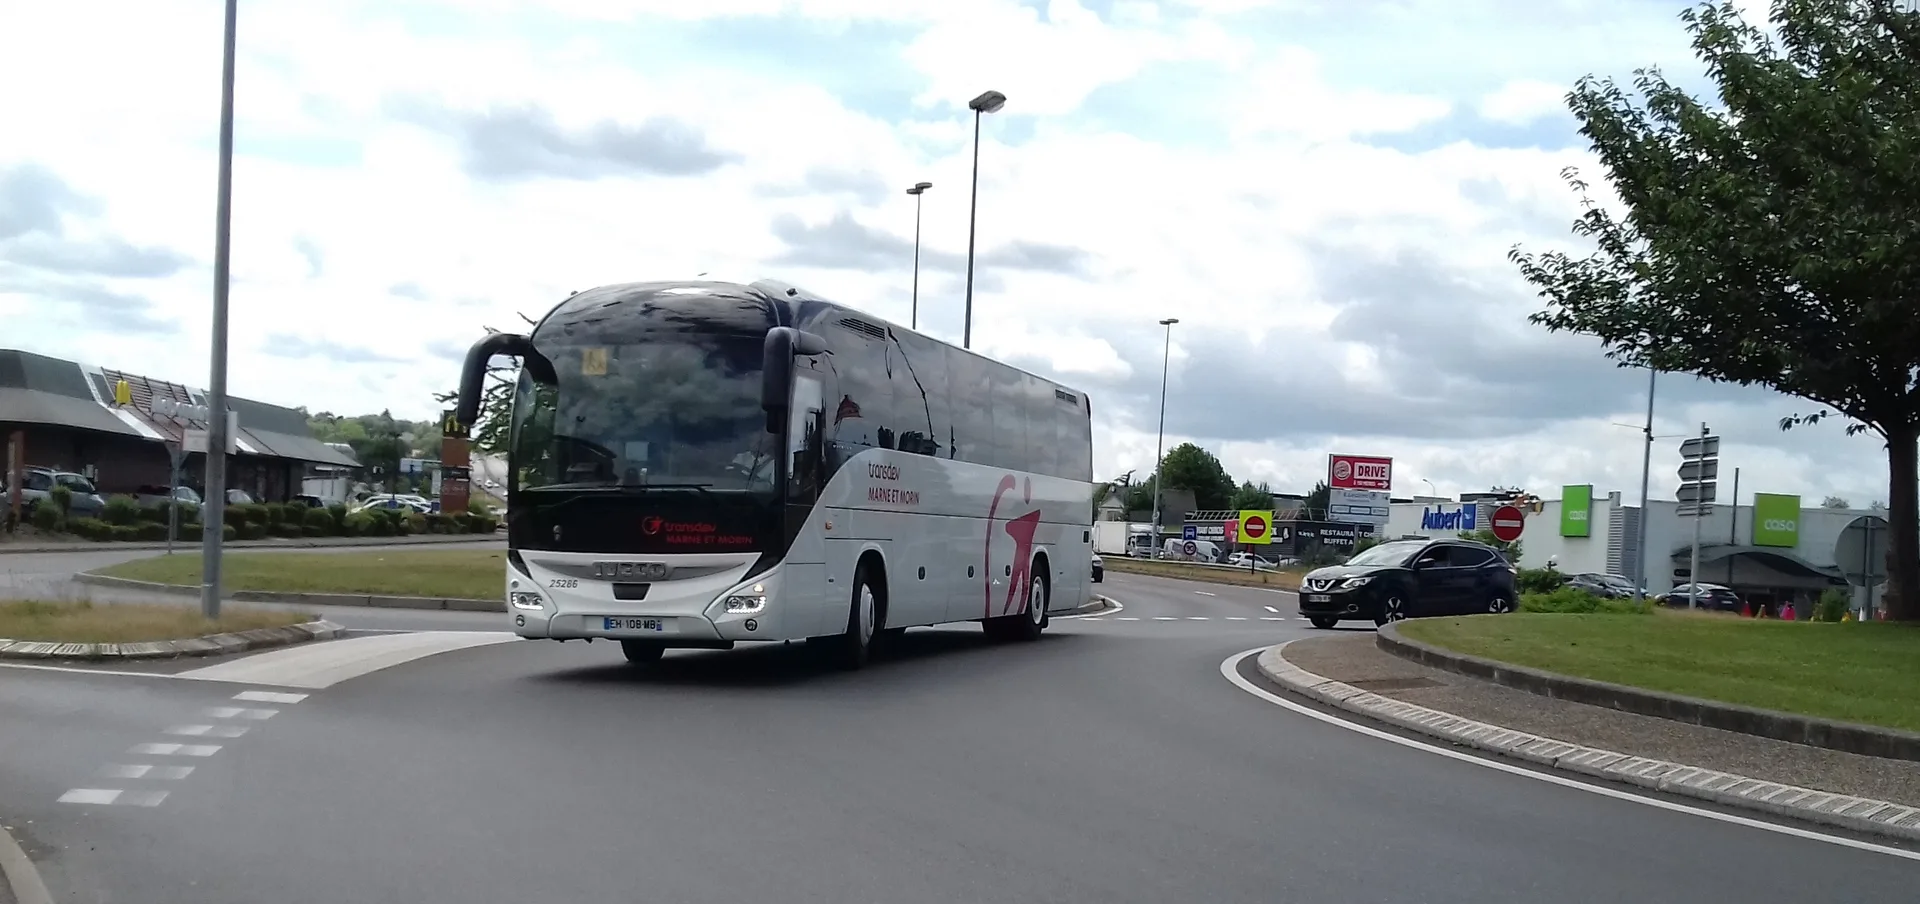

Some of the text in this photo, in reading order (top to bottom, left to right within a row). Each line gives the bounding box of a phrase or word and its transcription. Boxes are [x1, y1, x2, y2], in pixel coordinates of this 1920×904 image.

[868, 460, 900, 480] transdev
[1358, 465, 1386, 478] DRIVE
[868, 487, 920, 505] MARNE ET MORIN
[1421, 505, 1462, 530] Aubert
[664, 522, 716, 532] transdev
[1764, 519, 1795, 532] casa
[666, 534, 753, 544] MARNE ET MORIN
[1320, 529, 1362, 537] RESTAURAT
[595, 562, 666, 578] IVECO
[549, 580, 578, 588] 25286
